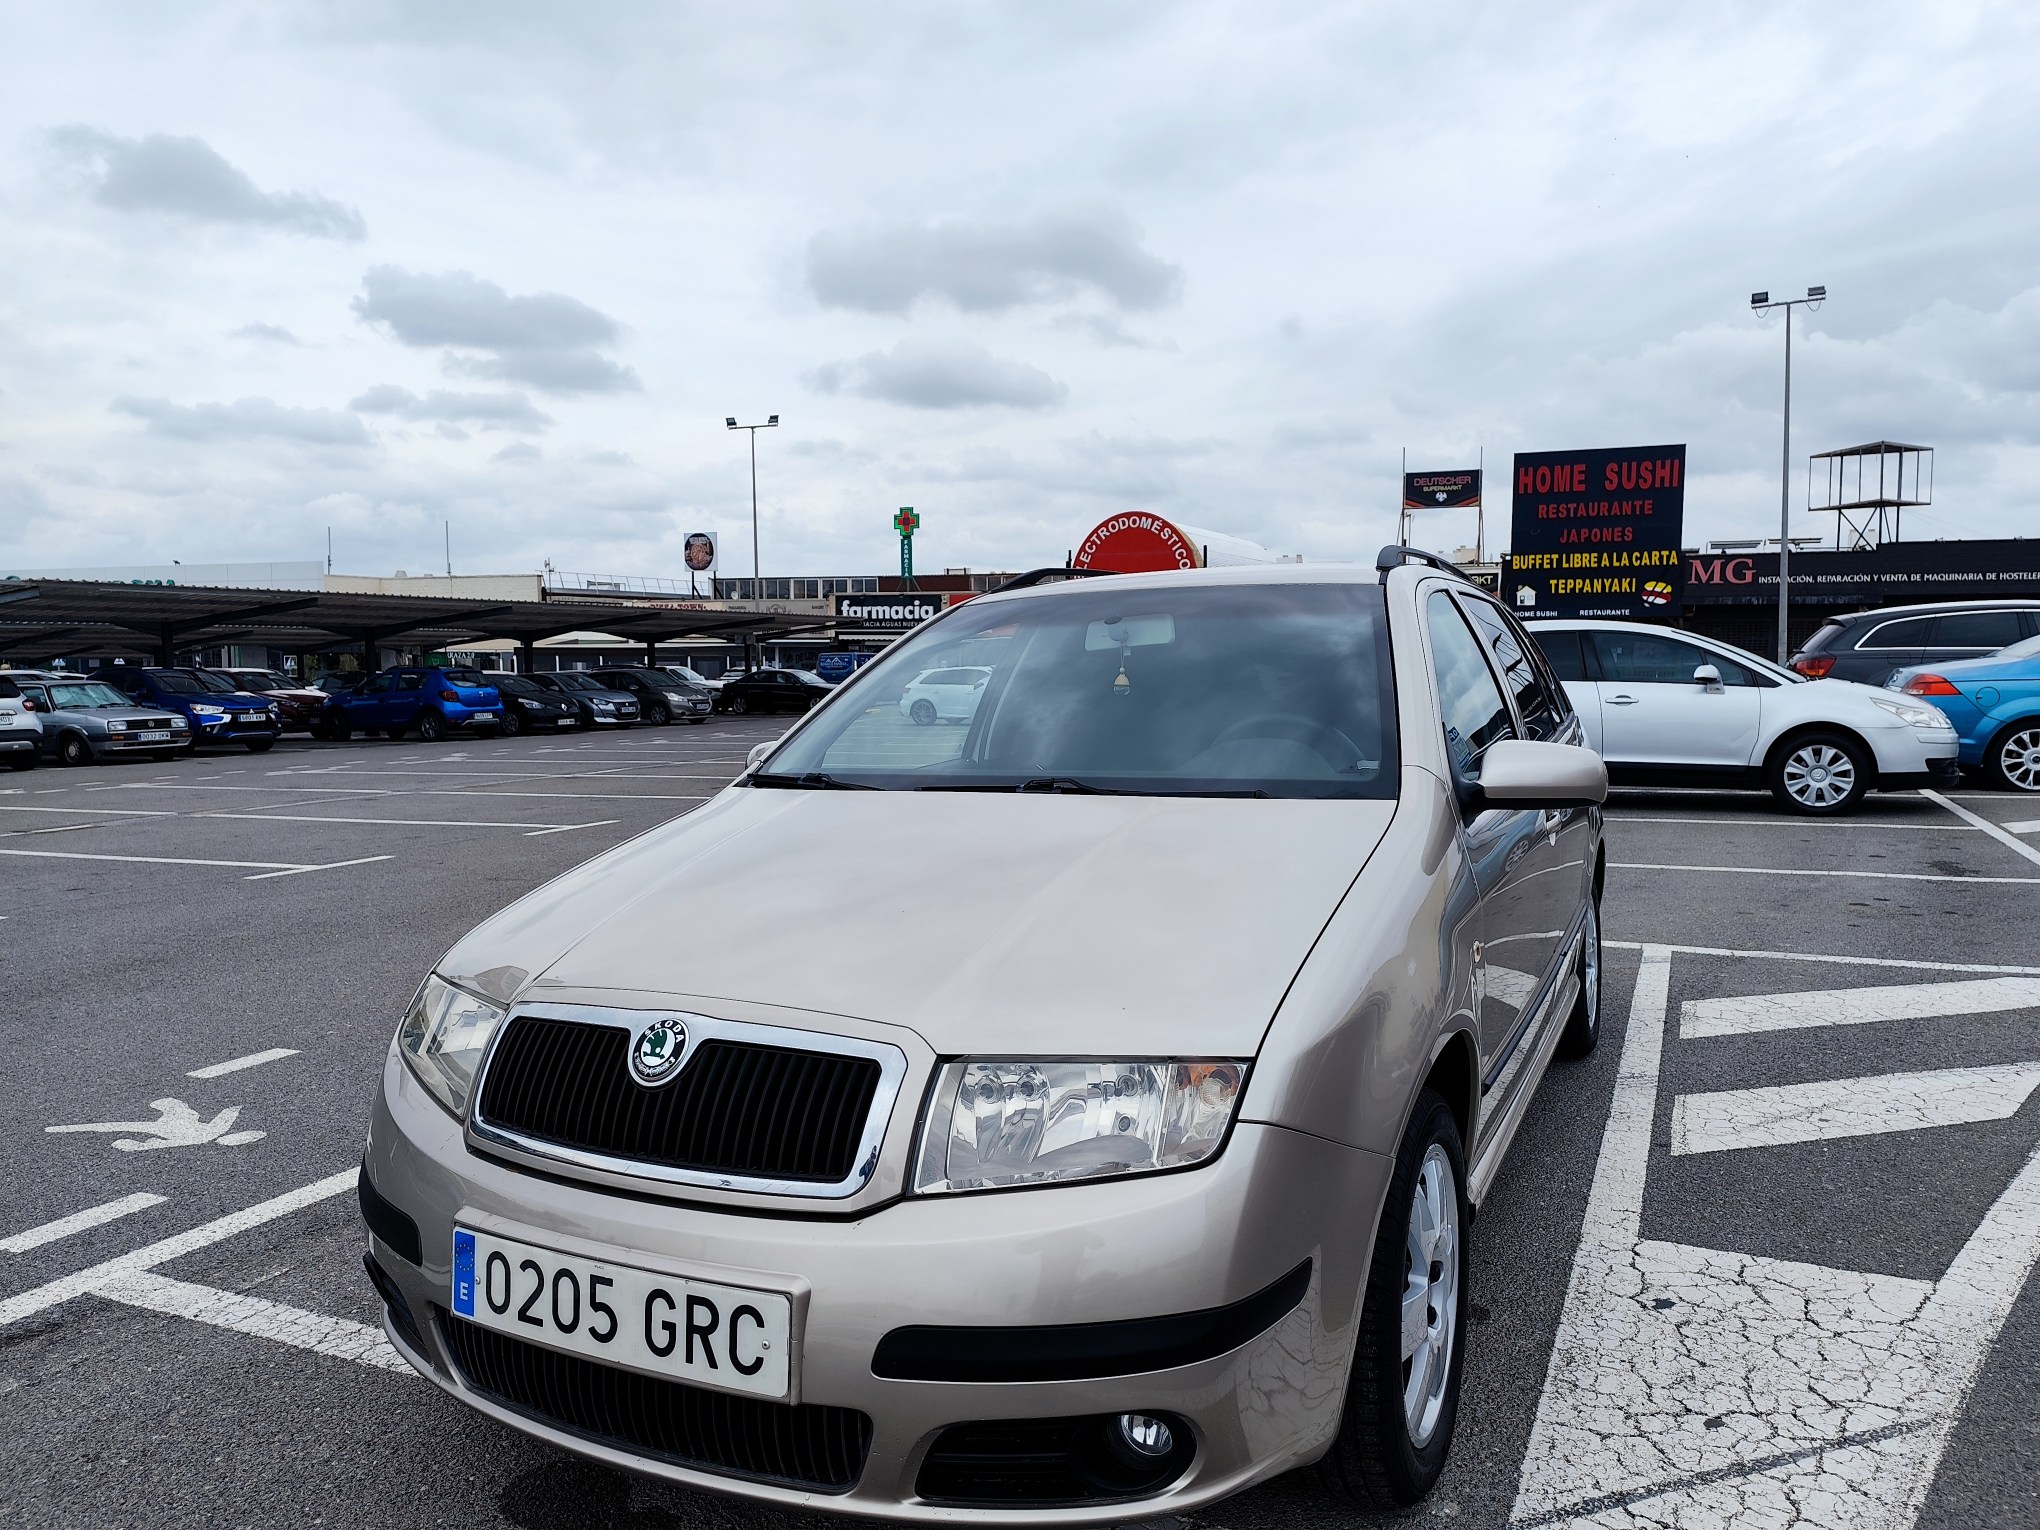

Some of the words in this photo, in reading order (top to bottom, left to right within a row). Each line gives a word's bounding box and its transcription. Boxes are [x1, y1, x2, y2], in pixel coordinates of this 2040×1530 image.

[1413, 475, 1472, 486] DEUTSCHER
[1518, 464, 1586, 494] HOME
[1604, 459, 1680, 490] SUSHI
[1538, 500, 1653, 518] RESTAURANTE
[1075, 515, 1192, 570] LECTRODOMÉSTICO
[1559, 527, 1633, 543] JAPONES
[1512, 553, 1559, 570] BUFFET
[1562, 552, 1598, 568] LIBRE
[1600, 551, 1610, 567] A
[1613, 551, 1629, 567] LA
[1632, 550, 1679, 566] CARTA
[1687, 558, 1757, 585] MG
[1758, 573, 1815, 585] INSTAACIÓN,
[1817, 572, 1871, 583] REPARACIÓN
[1873, 574, 1879, 582] Y
[1880, 573, 1909, 582] VENTA
[1911, 573, 1922, 581] DE
[1924, 572, 1984, 582] MAQUINARIA
[1986, 572, 1997, 581] DE
[1549, 577, 1636, 594] TEPPANYAKI
[841, 600, 935, 620] farmacia
[459, 1281, 469, 1301] E
[485, 1250, 618, 1344] 0205
[644, 1288, 765, 1376] GRC
